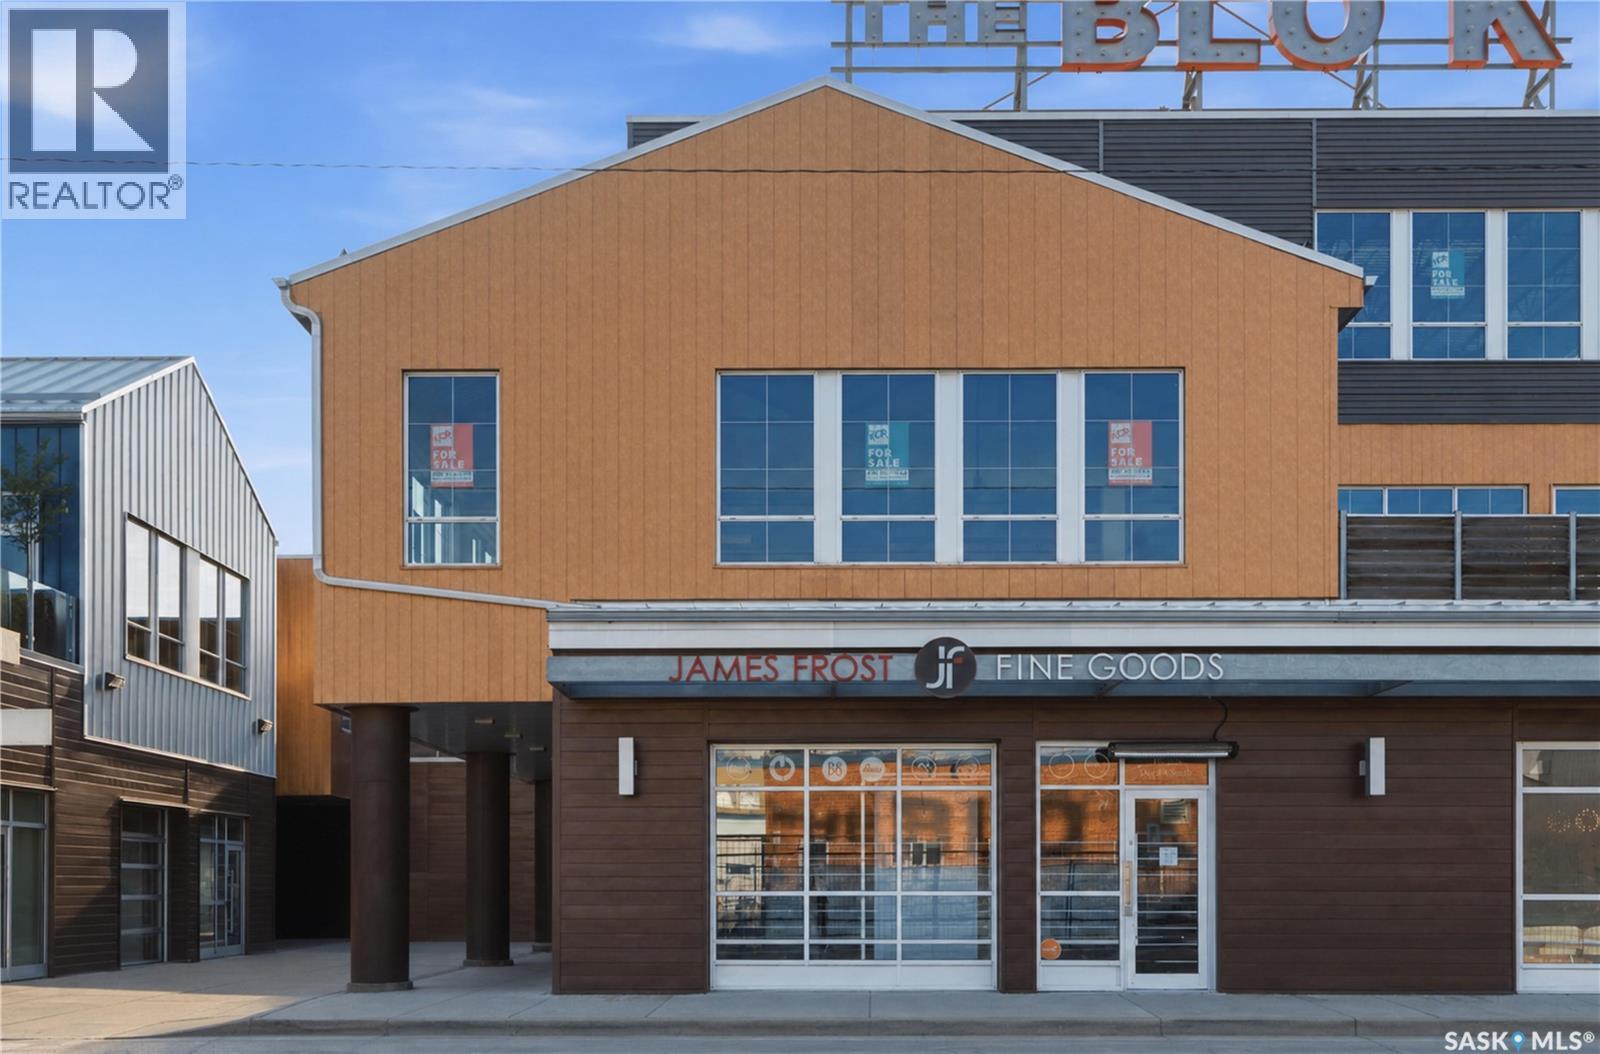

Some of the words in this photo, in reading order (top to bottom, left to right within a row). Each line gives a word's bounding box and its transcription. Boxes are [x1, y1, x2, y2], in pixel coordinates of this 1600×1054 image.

[432, 449, 457, 460] FOR
[868, 448, 892, 458] FOR
[1111, 447, 1136, 457] FOR
[432, 460, 465, 469] SALE
[868, 458, 900, 468] SALE
[1111, 457, 1143, 467] SALE
[668, 654, 779, 682] JAMES
[793, 653, 894, 682] FROST
[996, 653, 1074, 681] FINE
[1087, 652, 1225, 681] GOODS
